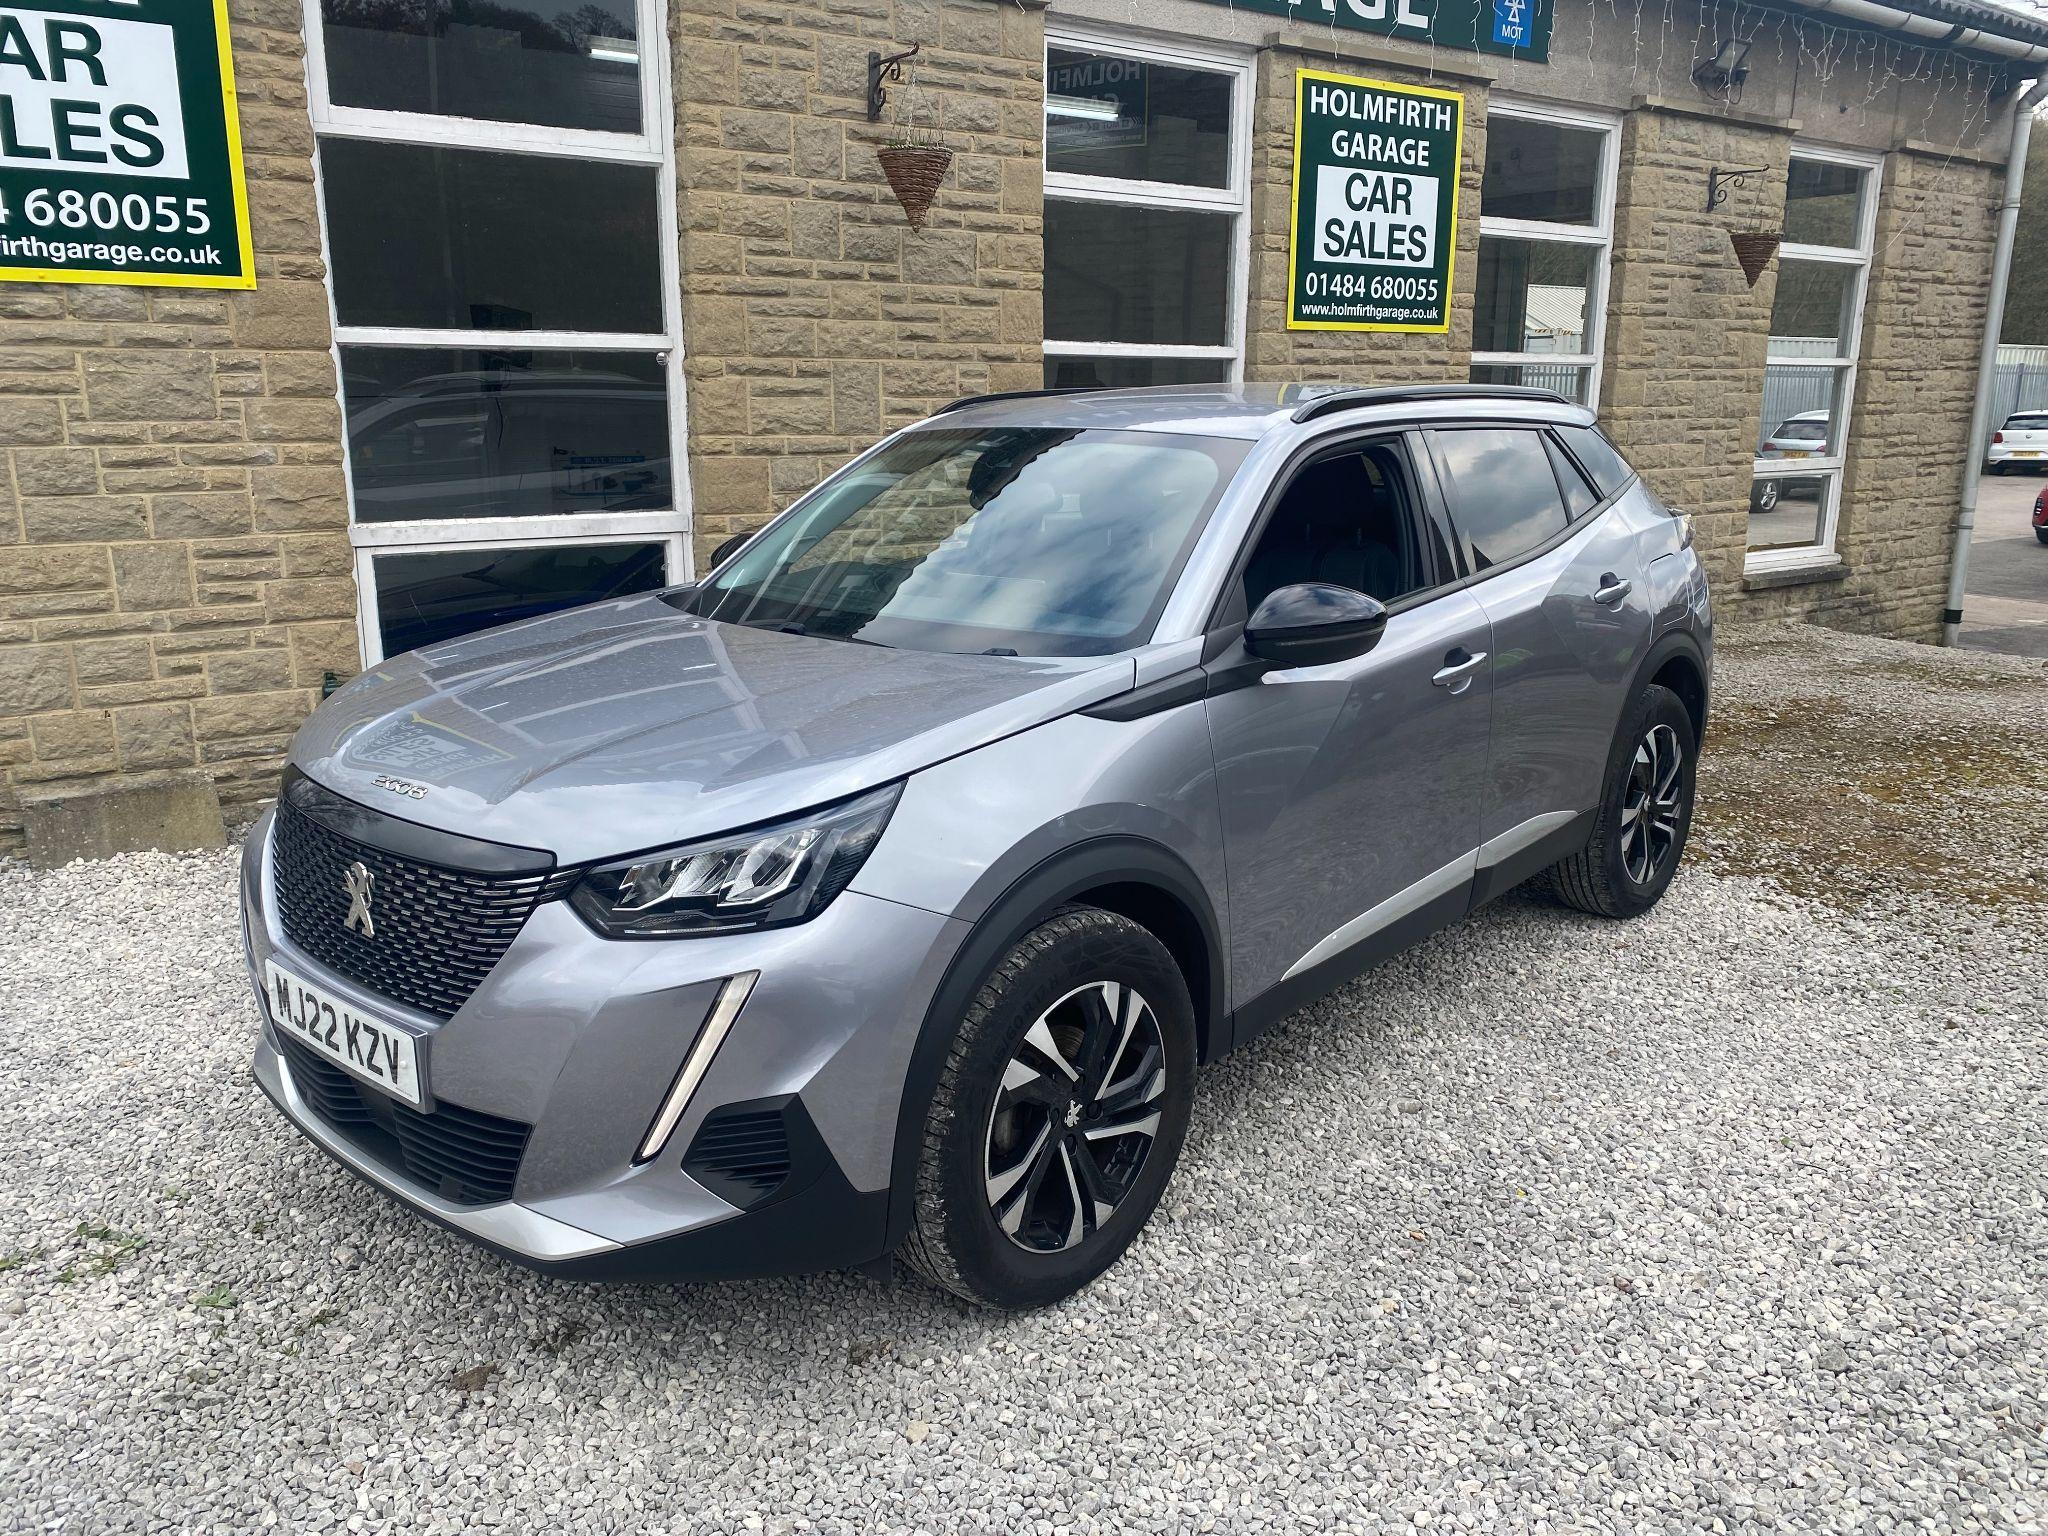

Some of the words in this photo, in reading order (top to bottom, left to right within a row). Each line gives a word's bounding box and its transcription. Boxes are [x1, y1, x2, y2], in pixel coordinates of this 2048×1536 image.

[1502, 24, 1523, 40] MOT
[1310, 85, 1451, 132] HOLMFIRTH
[1331, 129, 1430, 166] GARAGE
[24, 188, 211, 235] 680055
[1344, 172, 1412, 215] CAR
[0, 236, 222, 266] irthgarage.co.uk
[1323, 218, 1427, 262] SALES
[1305, 272, 1366, 298] 01484
[1370, 275, 1438, 301] 680055
[1302, 302, 1438, 319] www.holmfirthgarage.co.uk
[371, 774, 428, 799] 2008
[275, 972, 340, 1052] MJ22
[344, 1012, 399, 1085] KZV
